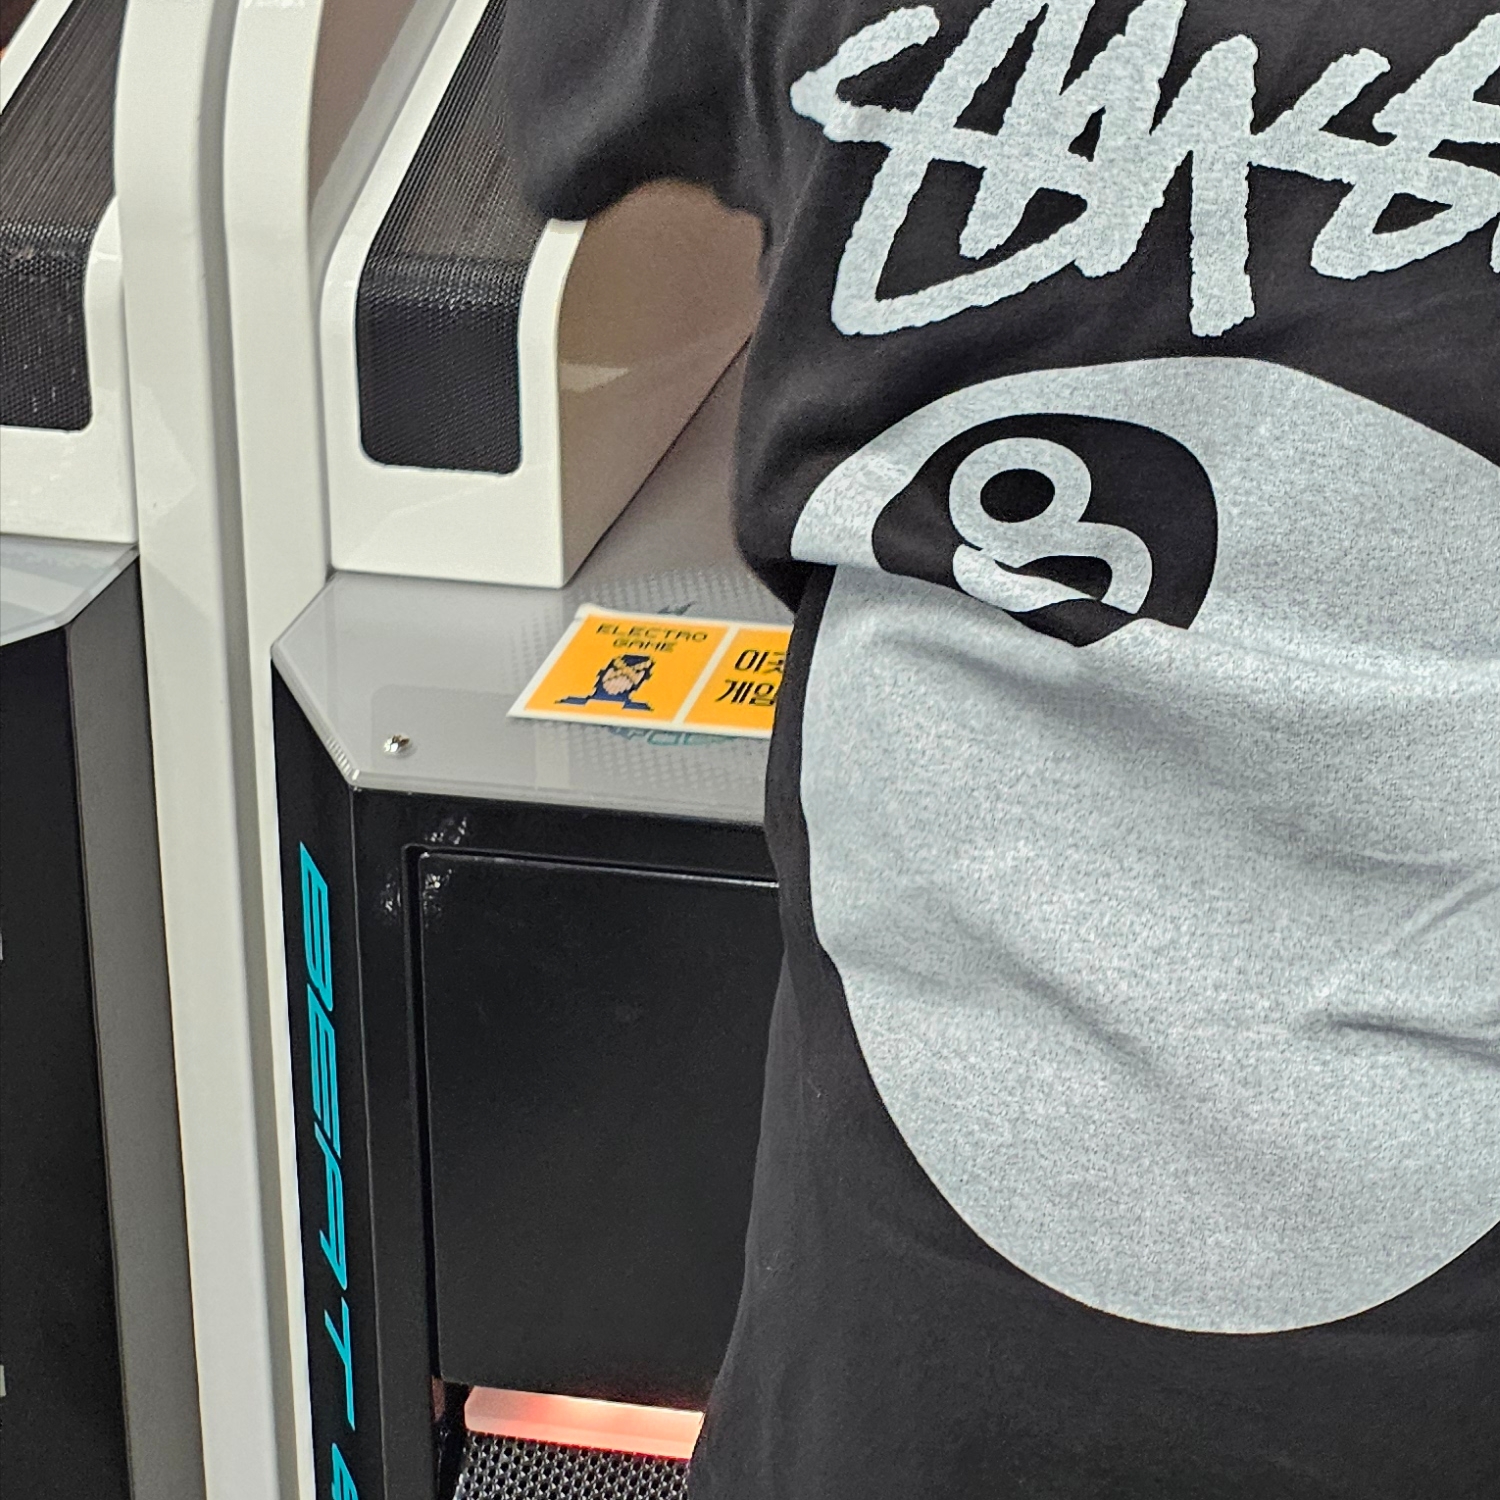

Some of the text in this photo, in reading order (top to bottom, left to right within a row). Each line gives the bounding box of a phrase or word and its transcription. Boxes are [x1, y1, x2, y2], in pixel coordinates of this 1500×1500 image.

[948, 436, 1153, 614] 8
[596, 622, 708, 644] ELECTRO
[612, 638, 678, 653] GAME
[300, 841, 356, 1432] BEAT
